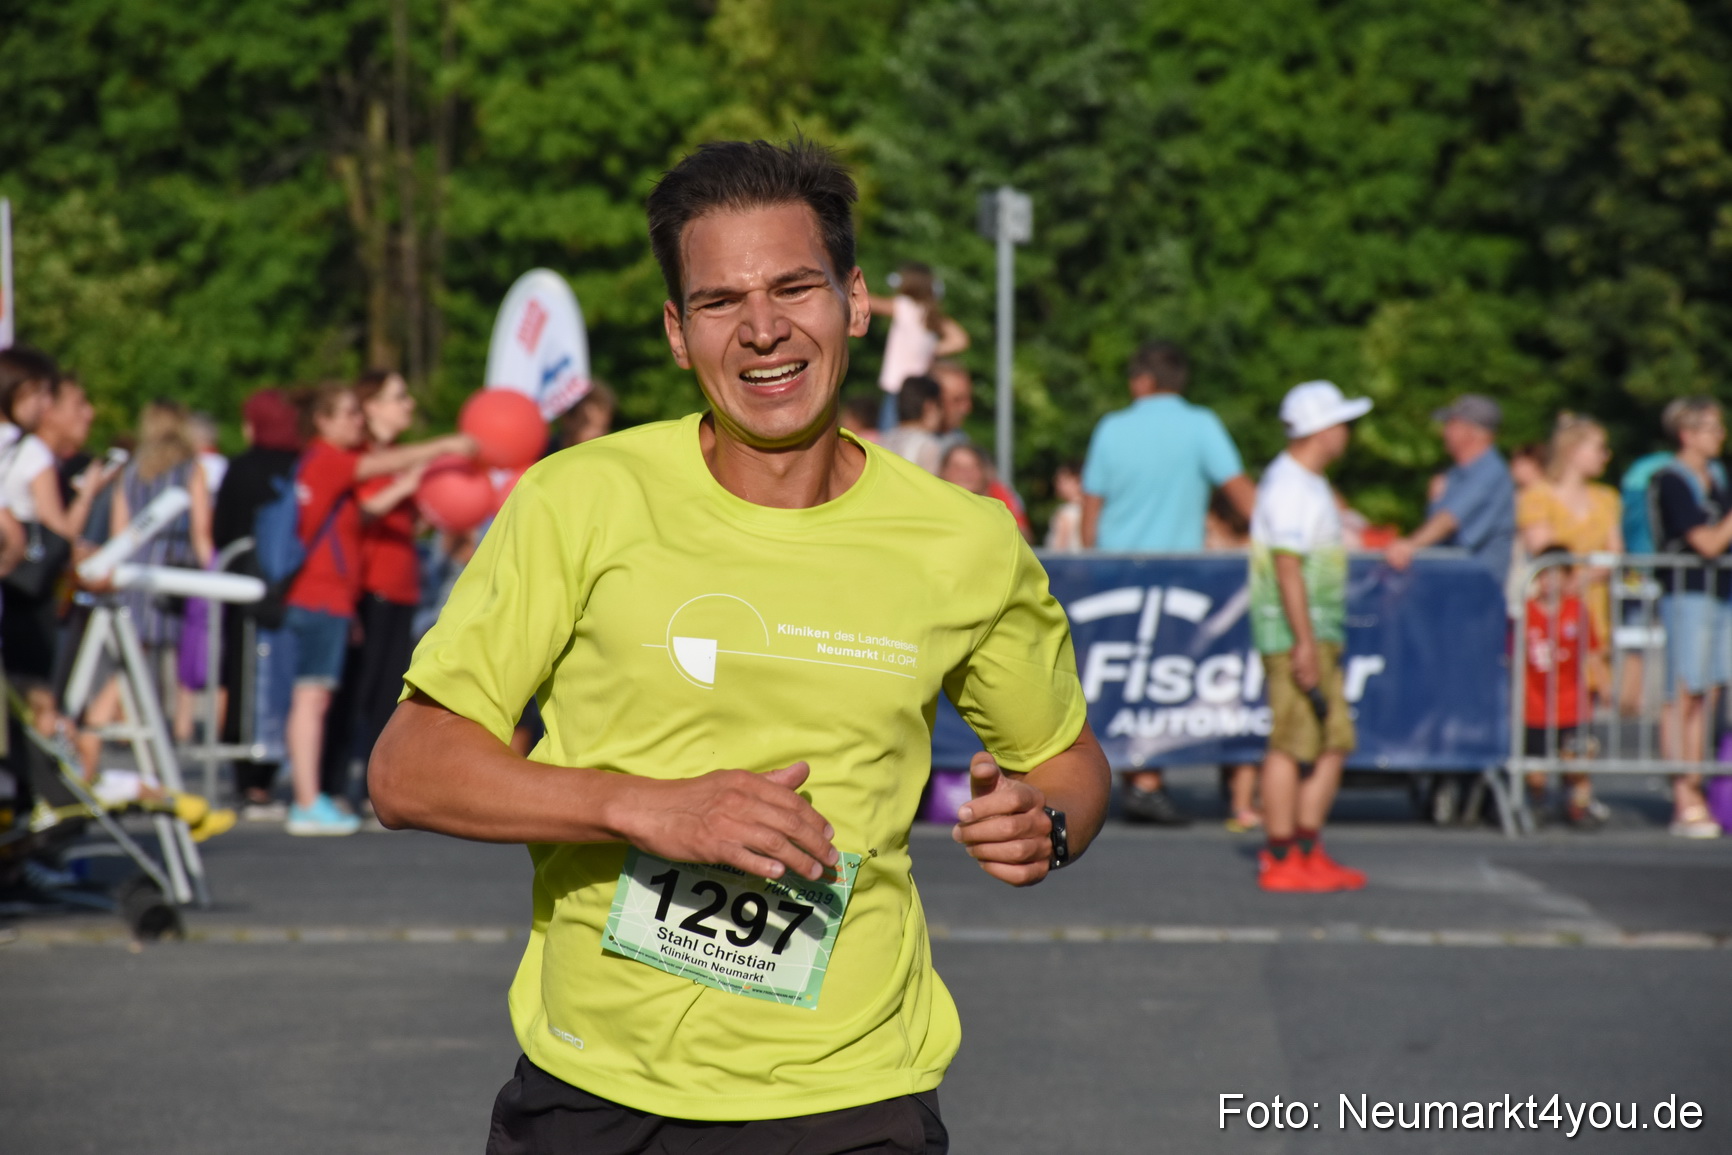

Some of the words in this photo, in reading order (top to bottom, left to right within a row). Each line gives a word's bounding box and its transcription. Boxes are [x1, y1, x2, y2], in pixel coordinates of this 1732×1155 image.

[777, 623, 830, 639] Kliniken
[834, 630, 855, 642] des
[858, 632, 919, 653] Landkreises
[817, 643, 878, 660] Neumarkt
[650, 868, 815, 956] 1297
[795, 888, 834, 905] 2019
[656, 926, 699, 952] Stahl
[703, 942, 776, 972] Christian
[660, 944, 708, 969] Klinikum
[711, 961, 764, 983] Neumarkt
